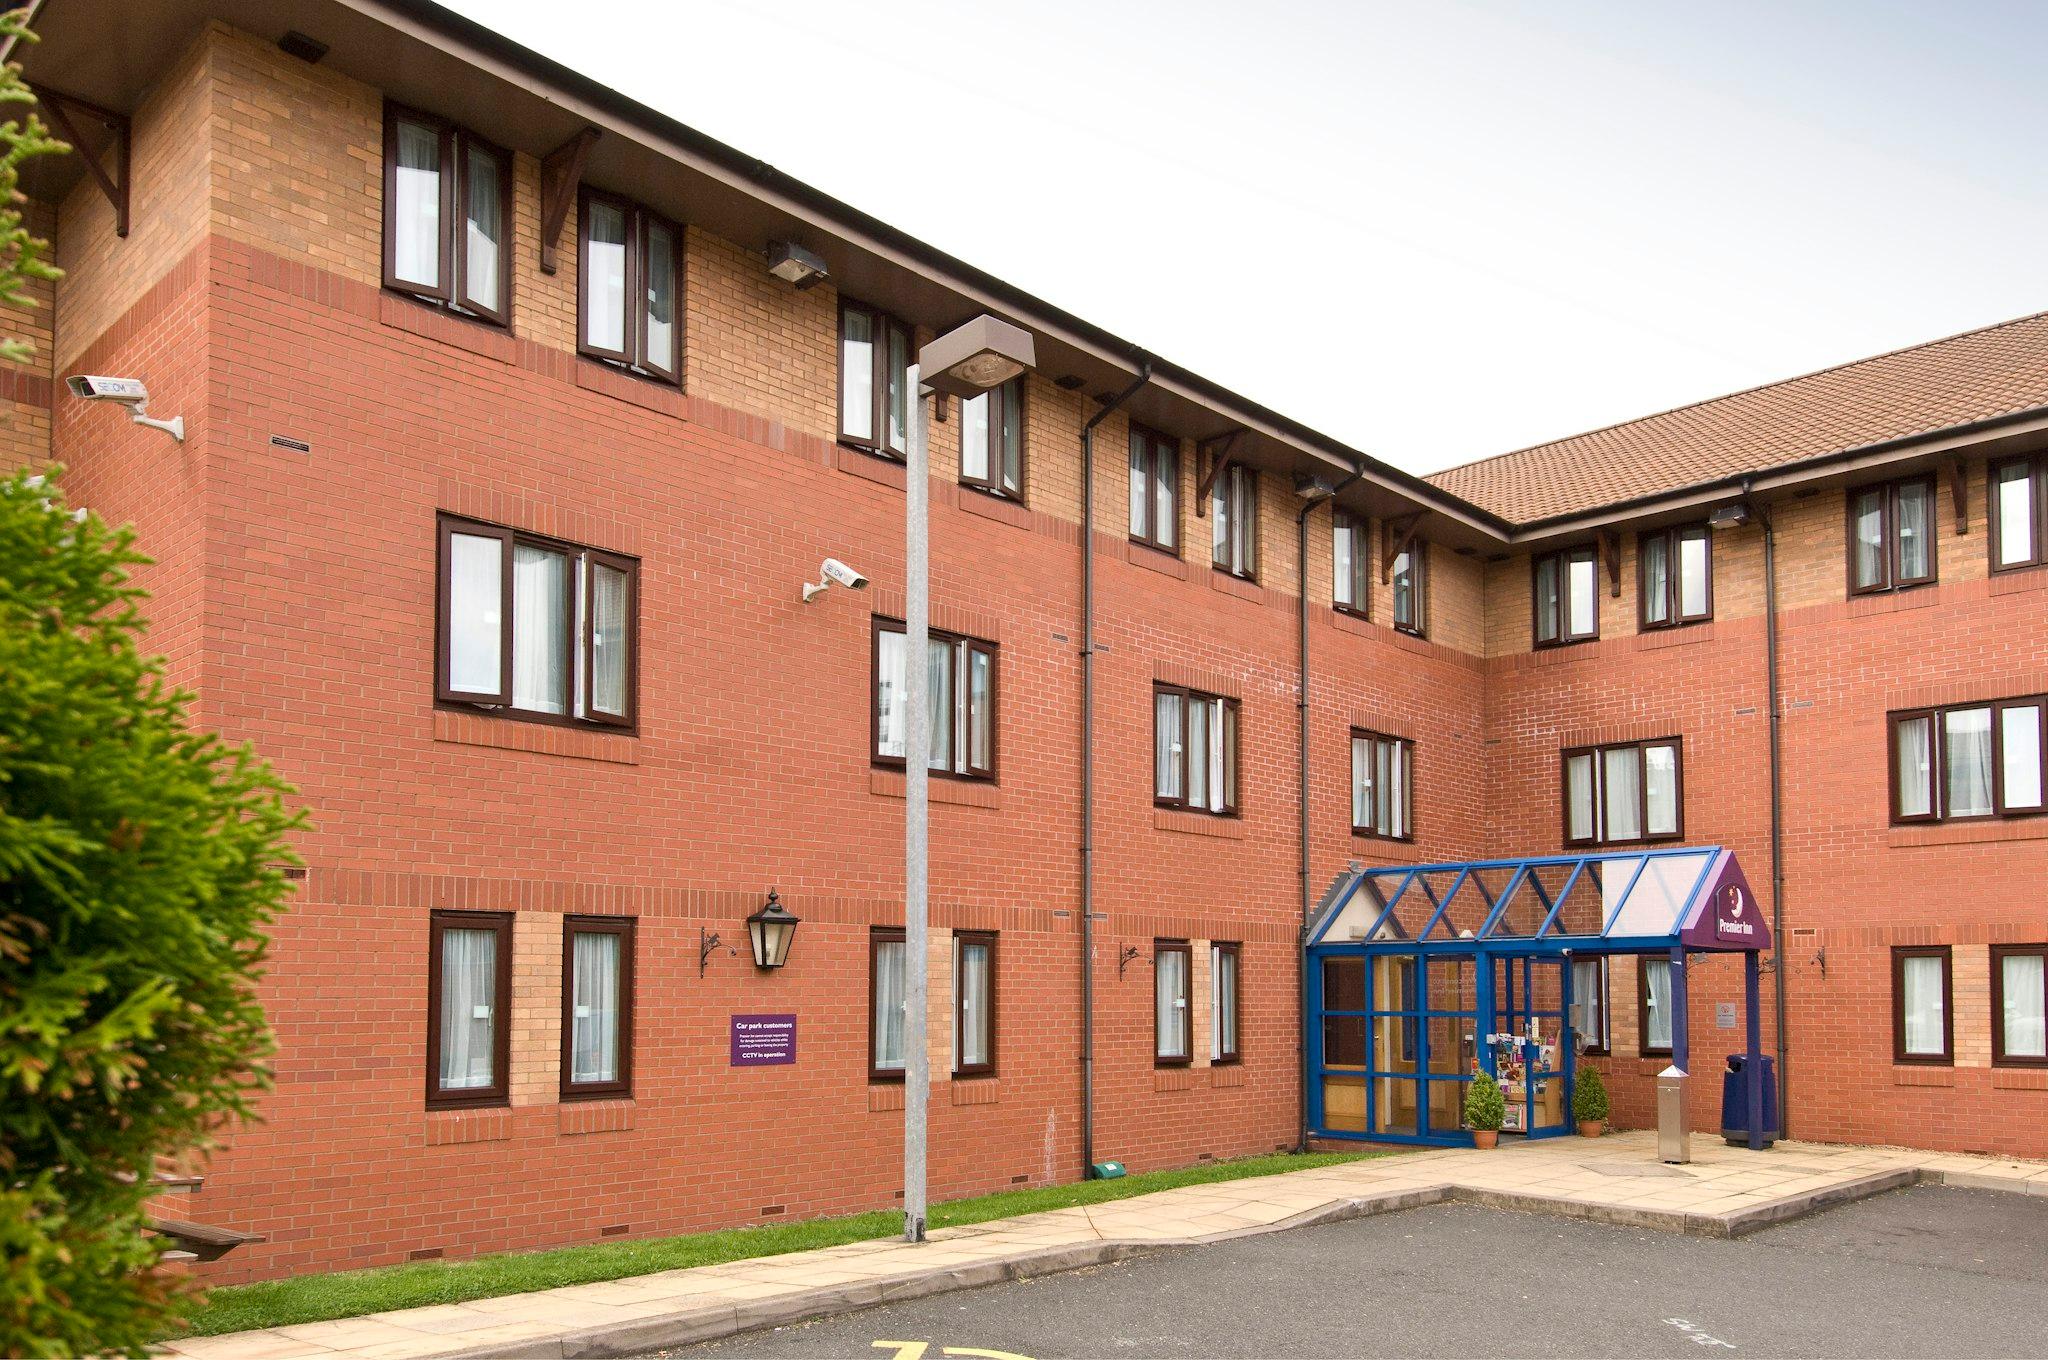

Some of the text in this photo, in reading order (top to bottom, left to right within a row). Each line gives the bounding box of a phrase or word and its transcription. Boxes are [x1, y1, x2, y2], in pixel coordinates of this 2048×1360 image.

[98, 382, 126, 392] SEOM
[826, 564, 843, 578] SEOM
[1720, 919, 1752, 934] Premier Inn
